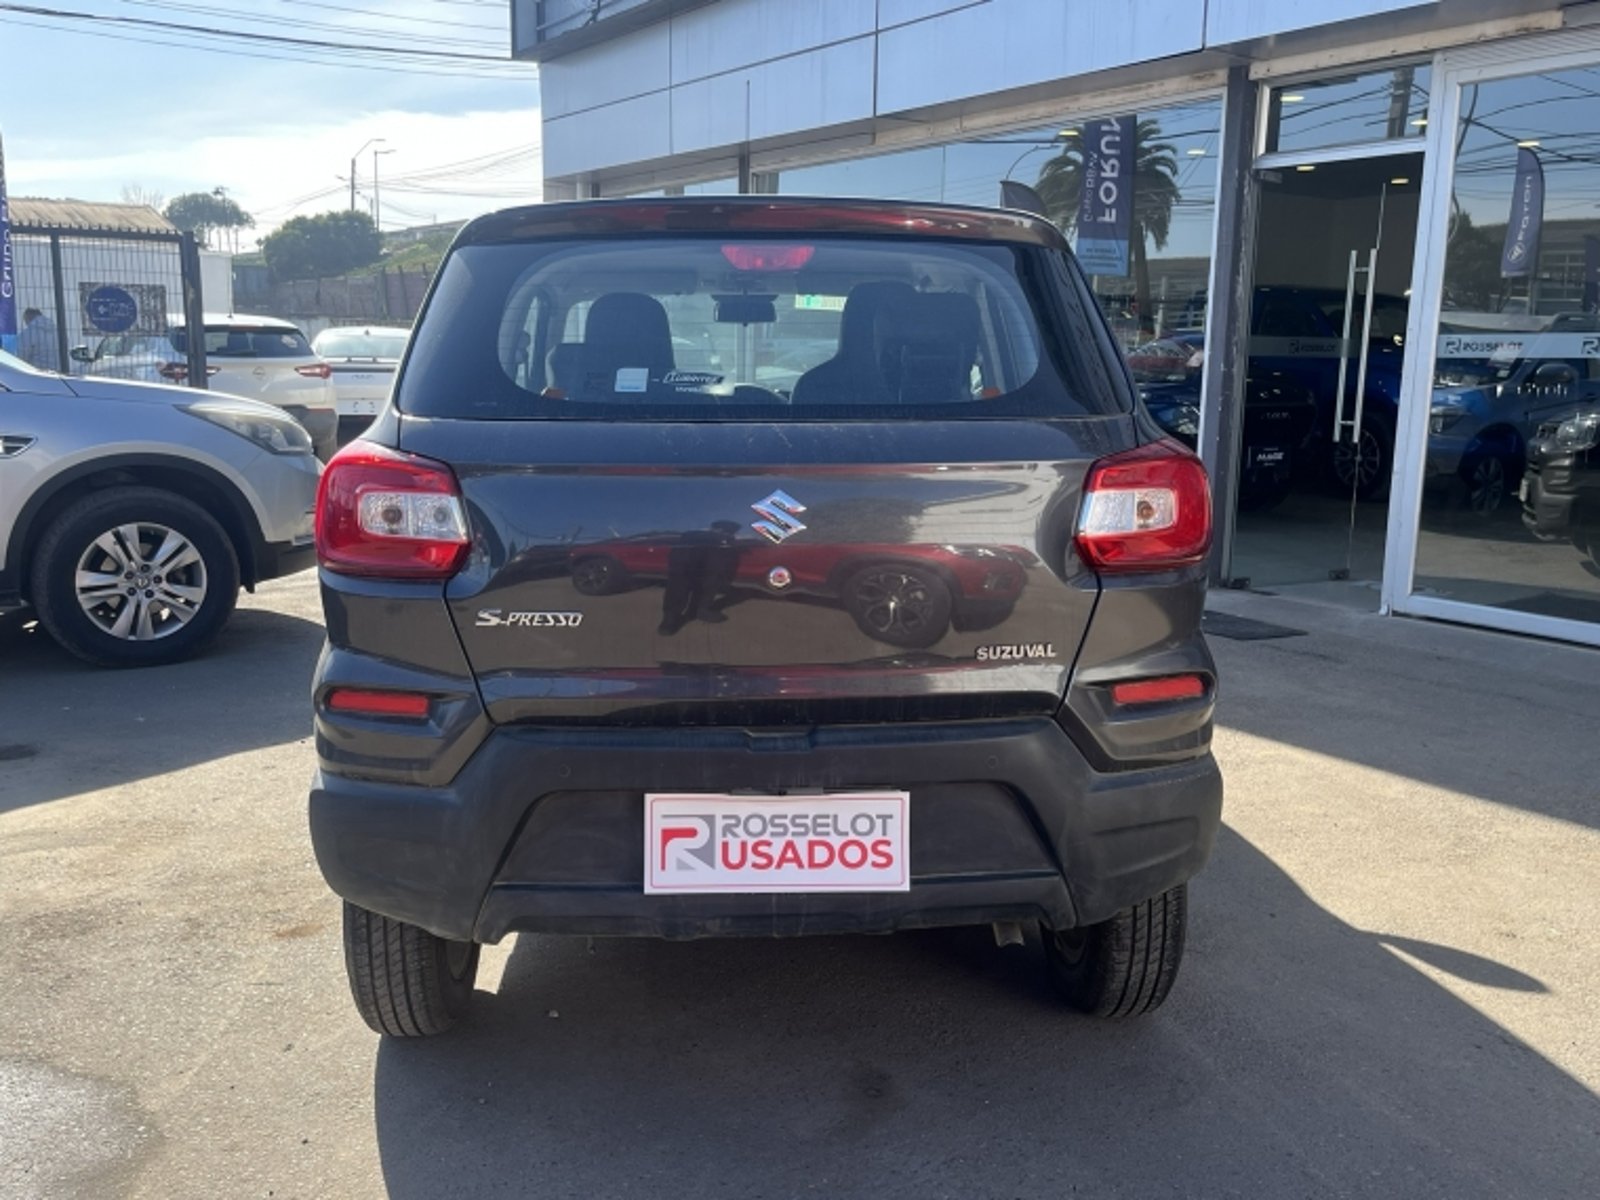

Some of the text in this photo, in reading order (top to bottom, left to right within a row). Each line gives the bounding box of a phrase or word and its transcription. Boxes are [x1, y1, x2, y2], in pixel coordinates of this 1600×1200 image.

[475, 609, 583, 626] S-PRESSO
[975, 644, 1056, 661] SUZUVAL
[721, 813, 893, 838] ROSSELOT
[721, 839, 894, 870] USADOS
